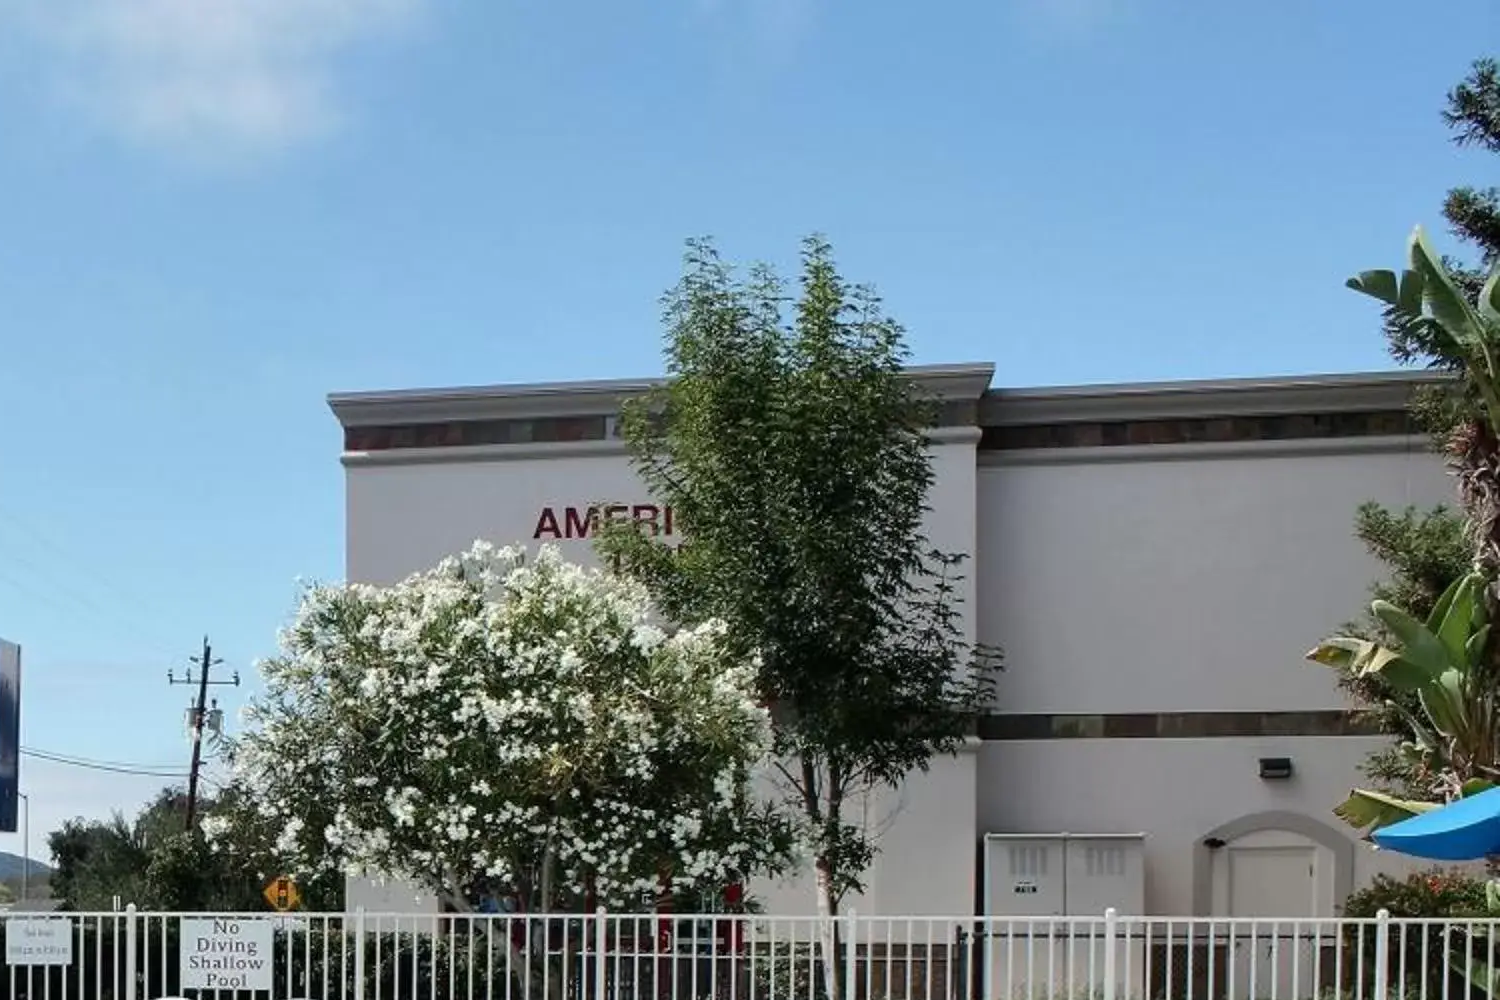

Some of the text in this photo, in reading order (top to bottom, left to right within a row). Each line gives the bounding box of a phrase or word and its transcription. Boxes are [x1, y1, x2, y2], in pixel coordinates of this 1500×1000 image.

[213, 920, 240, 935] No
[196, 938, 258, 956] Diving
[189, 956, 263, 970] Shallow
[207, 973, 248, 988] Pool
